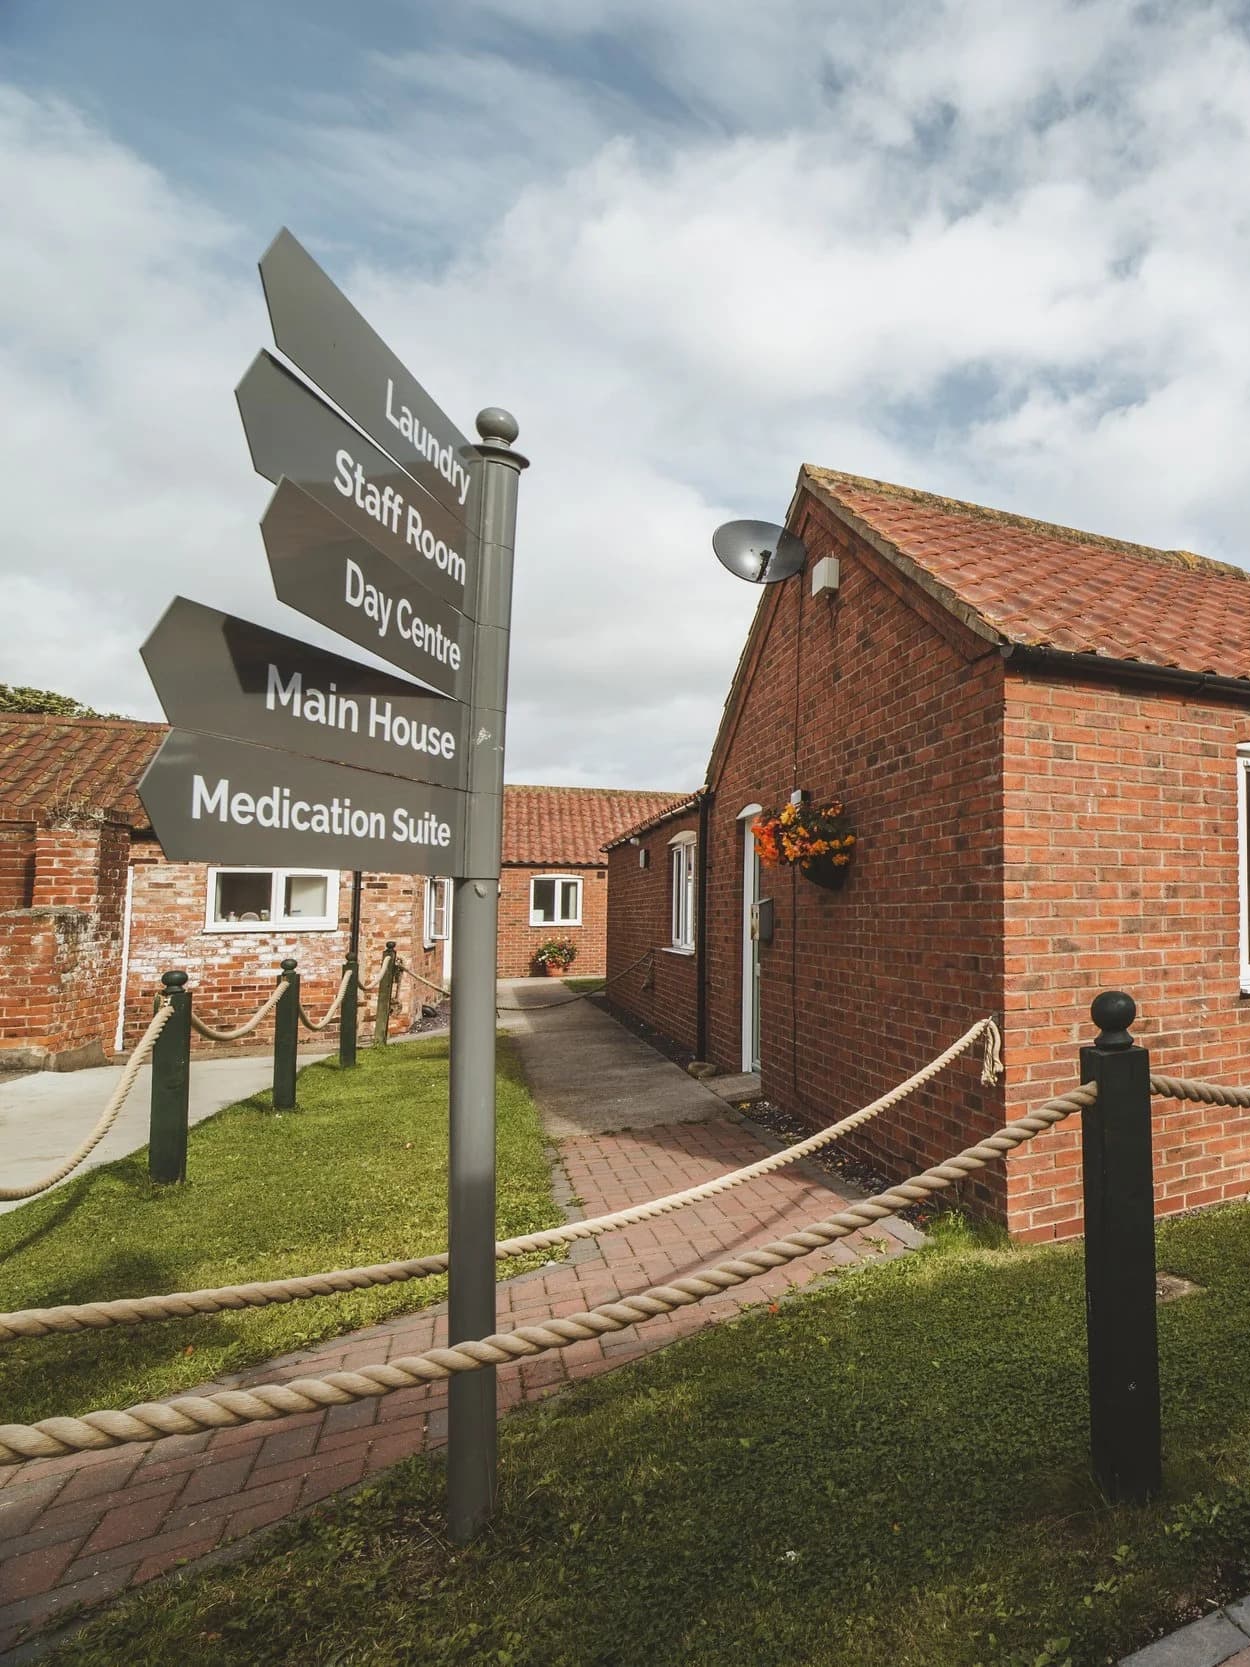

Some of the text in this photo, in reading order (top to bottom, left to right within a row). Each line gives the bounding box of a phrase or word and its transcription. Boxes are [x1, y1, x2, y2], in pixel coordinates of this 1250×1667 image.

[386, 379, 471, 506] Laundry
[333, 449, 468, 586] Staff Room
[345, 558, 461, 671] Day Centre
[265, 663, 456, 759] Main House
[191, 774, 451, 847] Medication Suite
